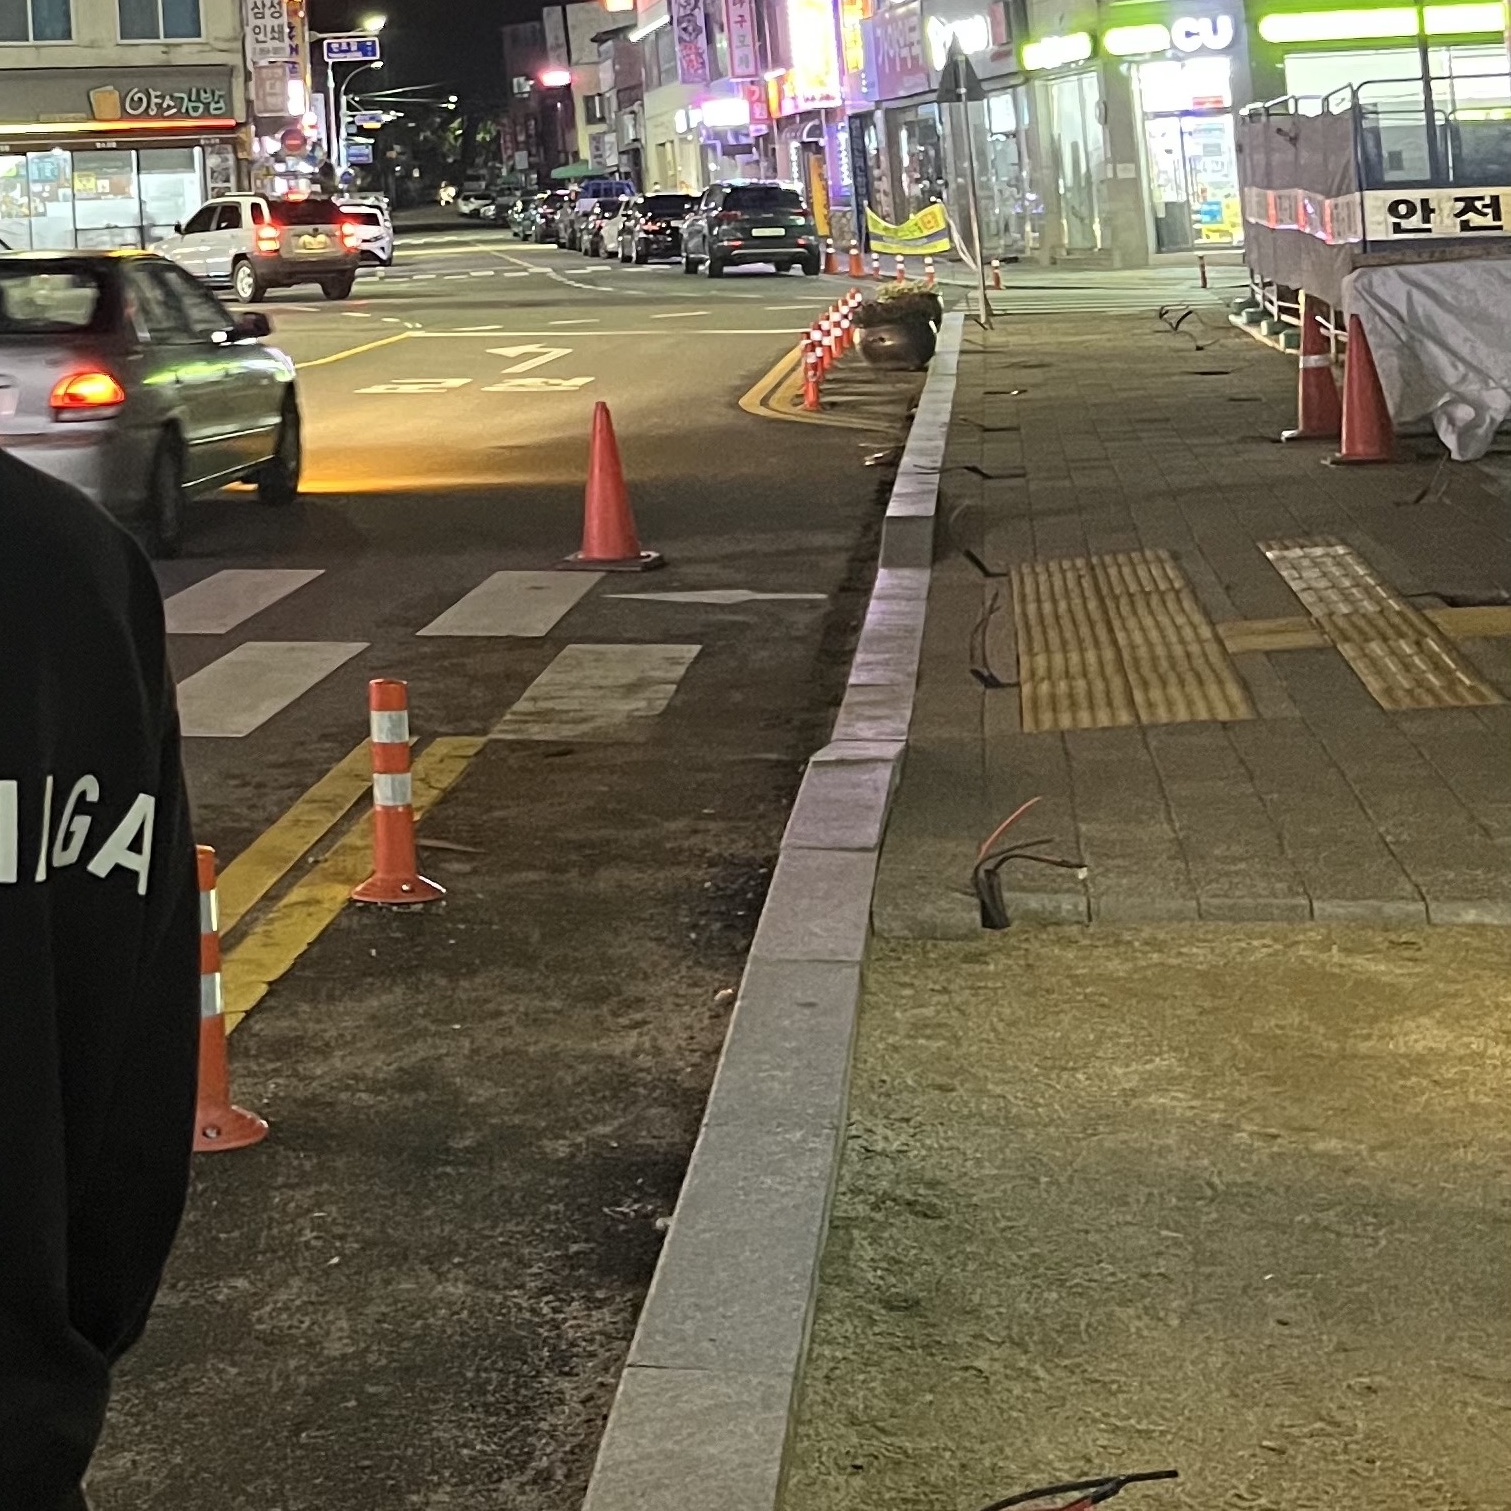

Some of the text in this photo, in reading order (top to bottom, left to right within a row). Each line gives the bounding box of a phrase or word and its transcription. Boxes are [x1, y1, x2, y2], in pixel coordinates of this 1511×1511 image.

[250, 0, 283, 20] 삼성
[252, 23, 285, 44] 인쇄
[1170, 14, 1234, 53] CU
[125, 88, 227, 117] 양스김밥
[1387, 194, 1504, 235] 안전
